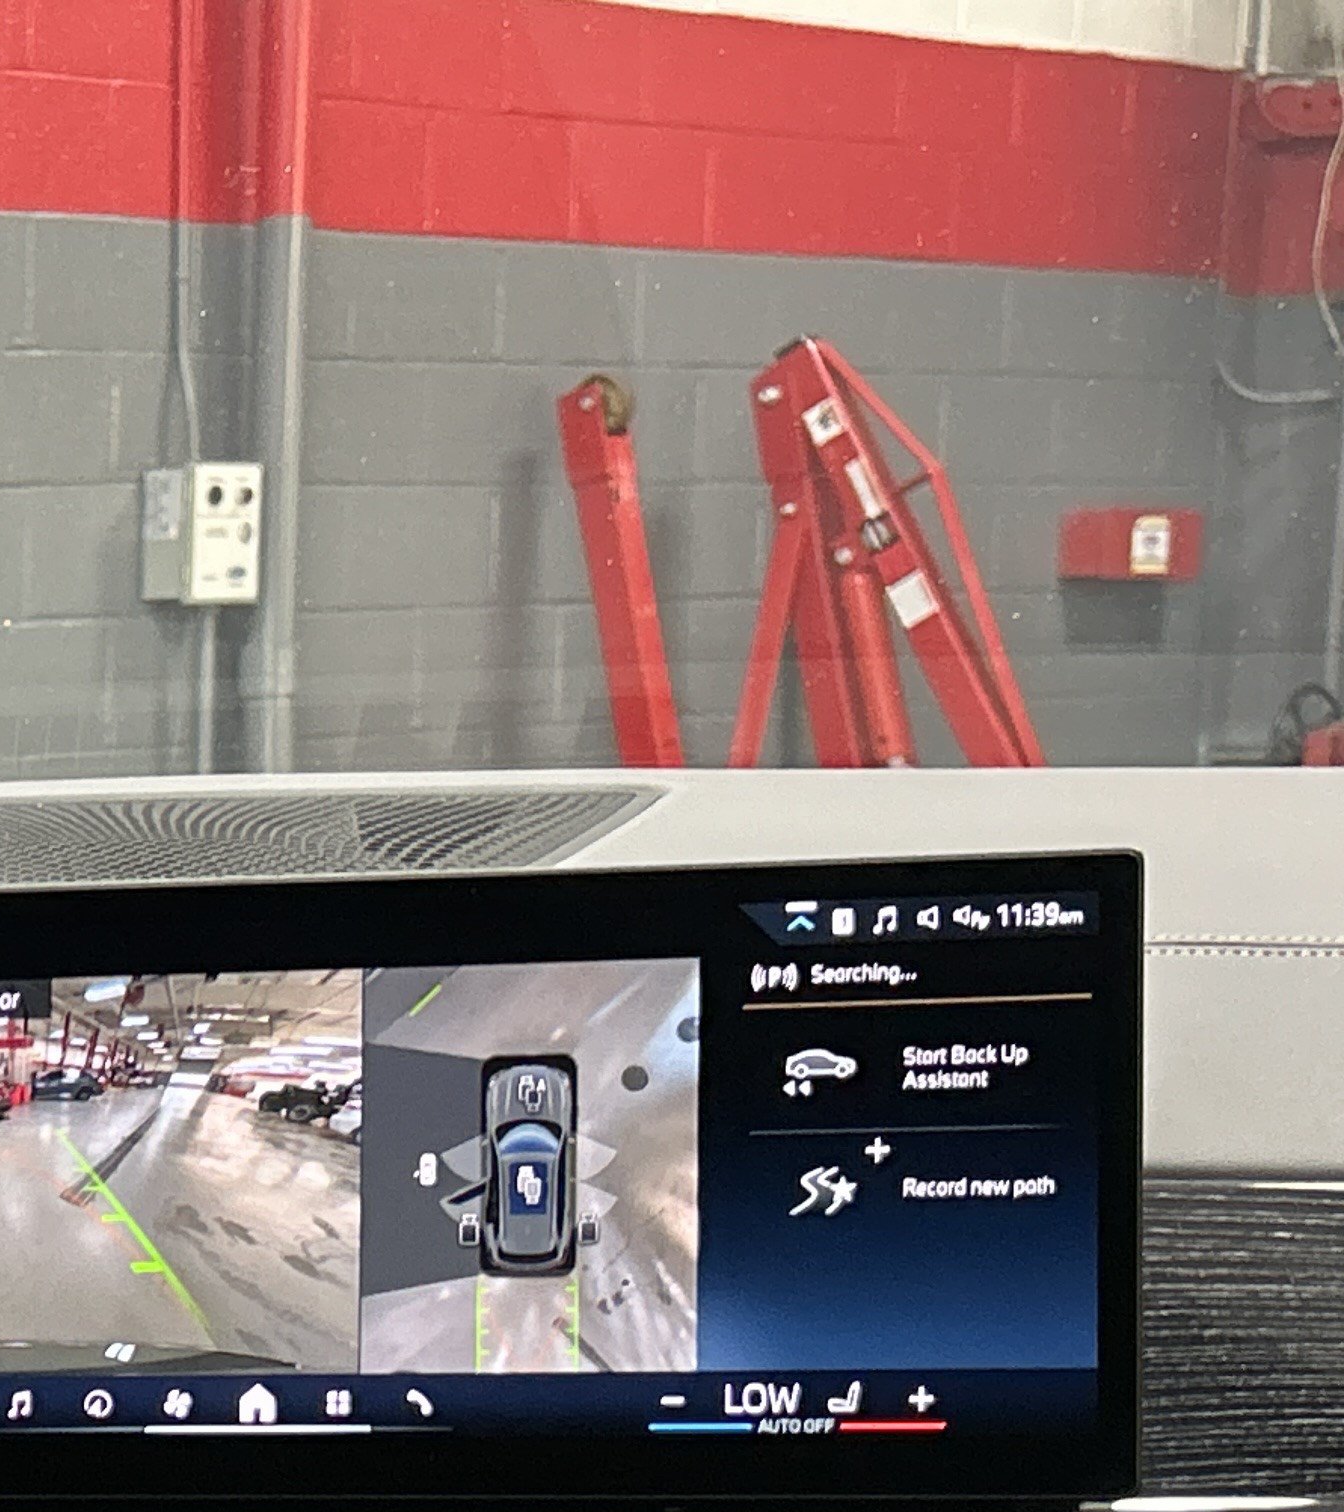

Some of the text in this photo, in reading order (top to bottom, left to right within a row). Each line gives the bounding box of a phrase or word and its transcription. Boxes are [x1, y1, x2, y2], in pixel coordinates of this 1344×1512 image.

[902, 1043, 1029, 1068] Start Back Up
[901, 1070, 989, 1090] Assistant
[902, 1175, 1056, 1200] Record new path
[724, 1382, 801, 1415] LOW
[757, 1417, 835, 1434] AUTO OFF
